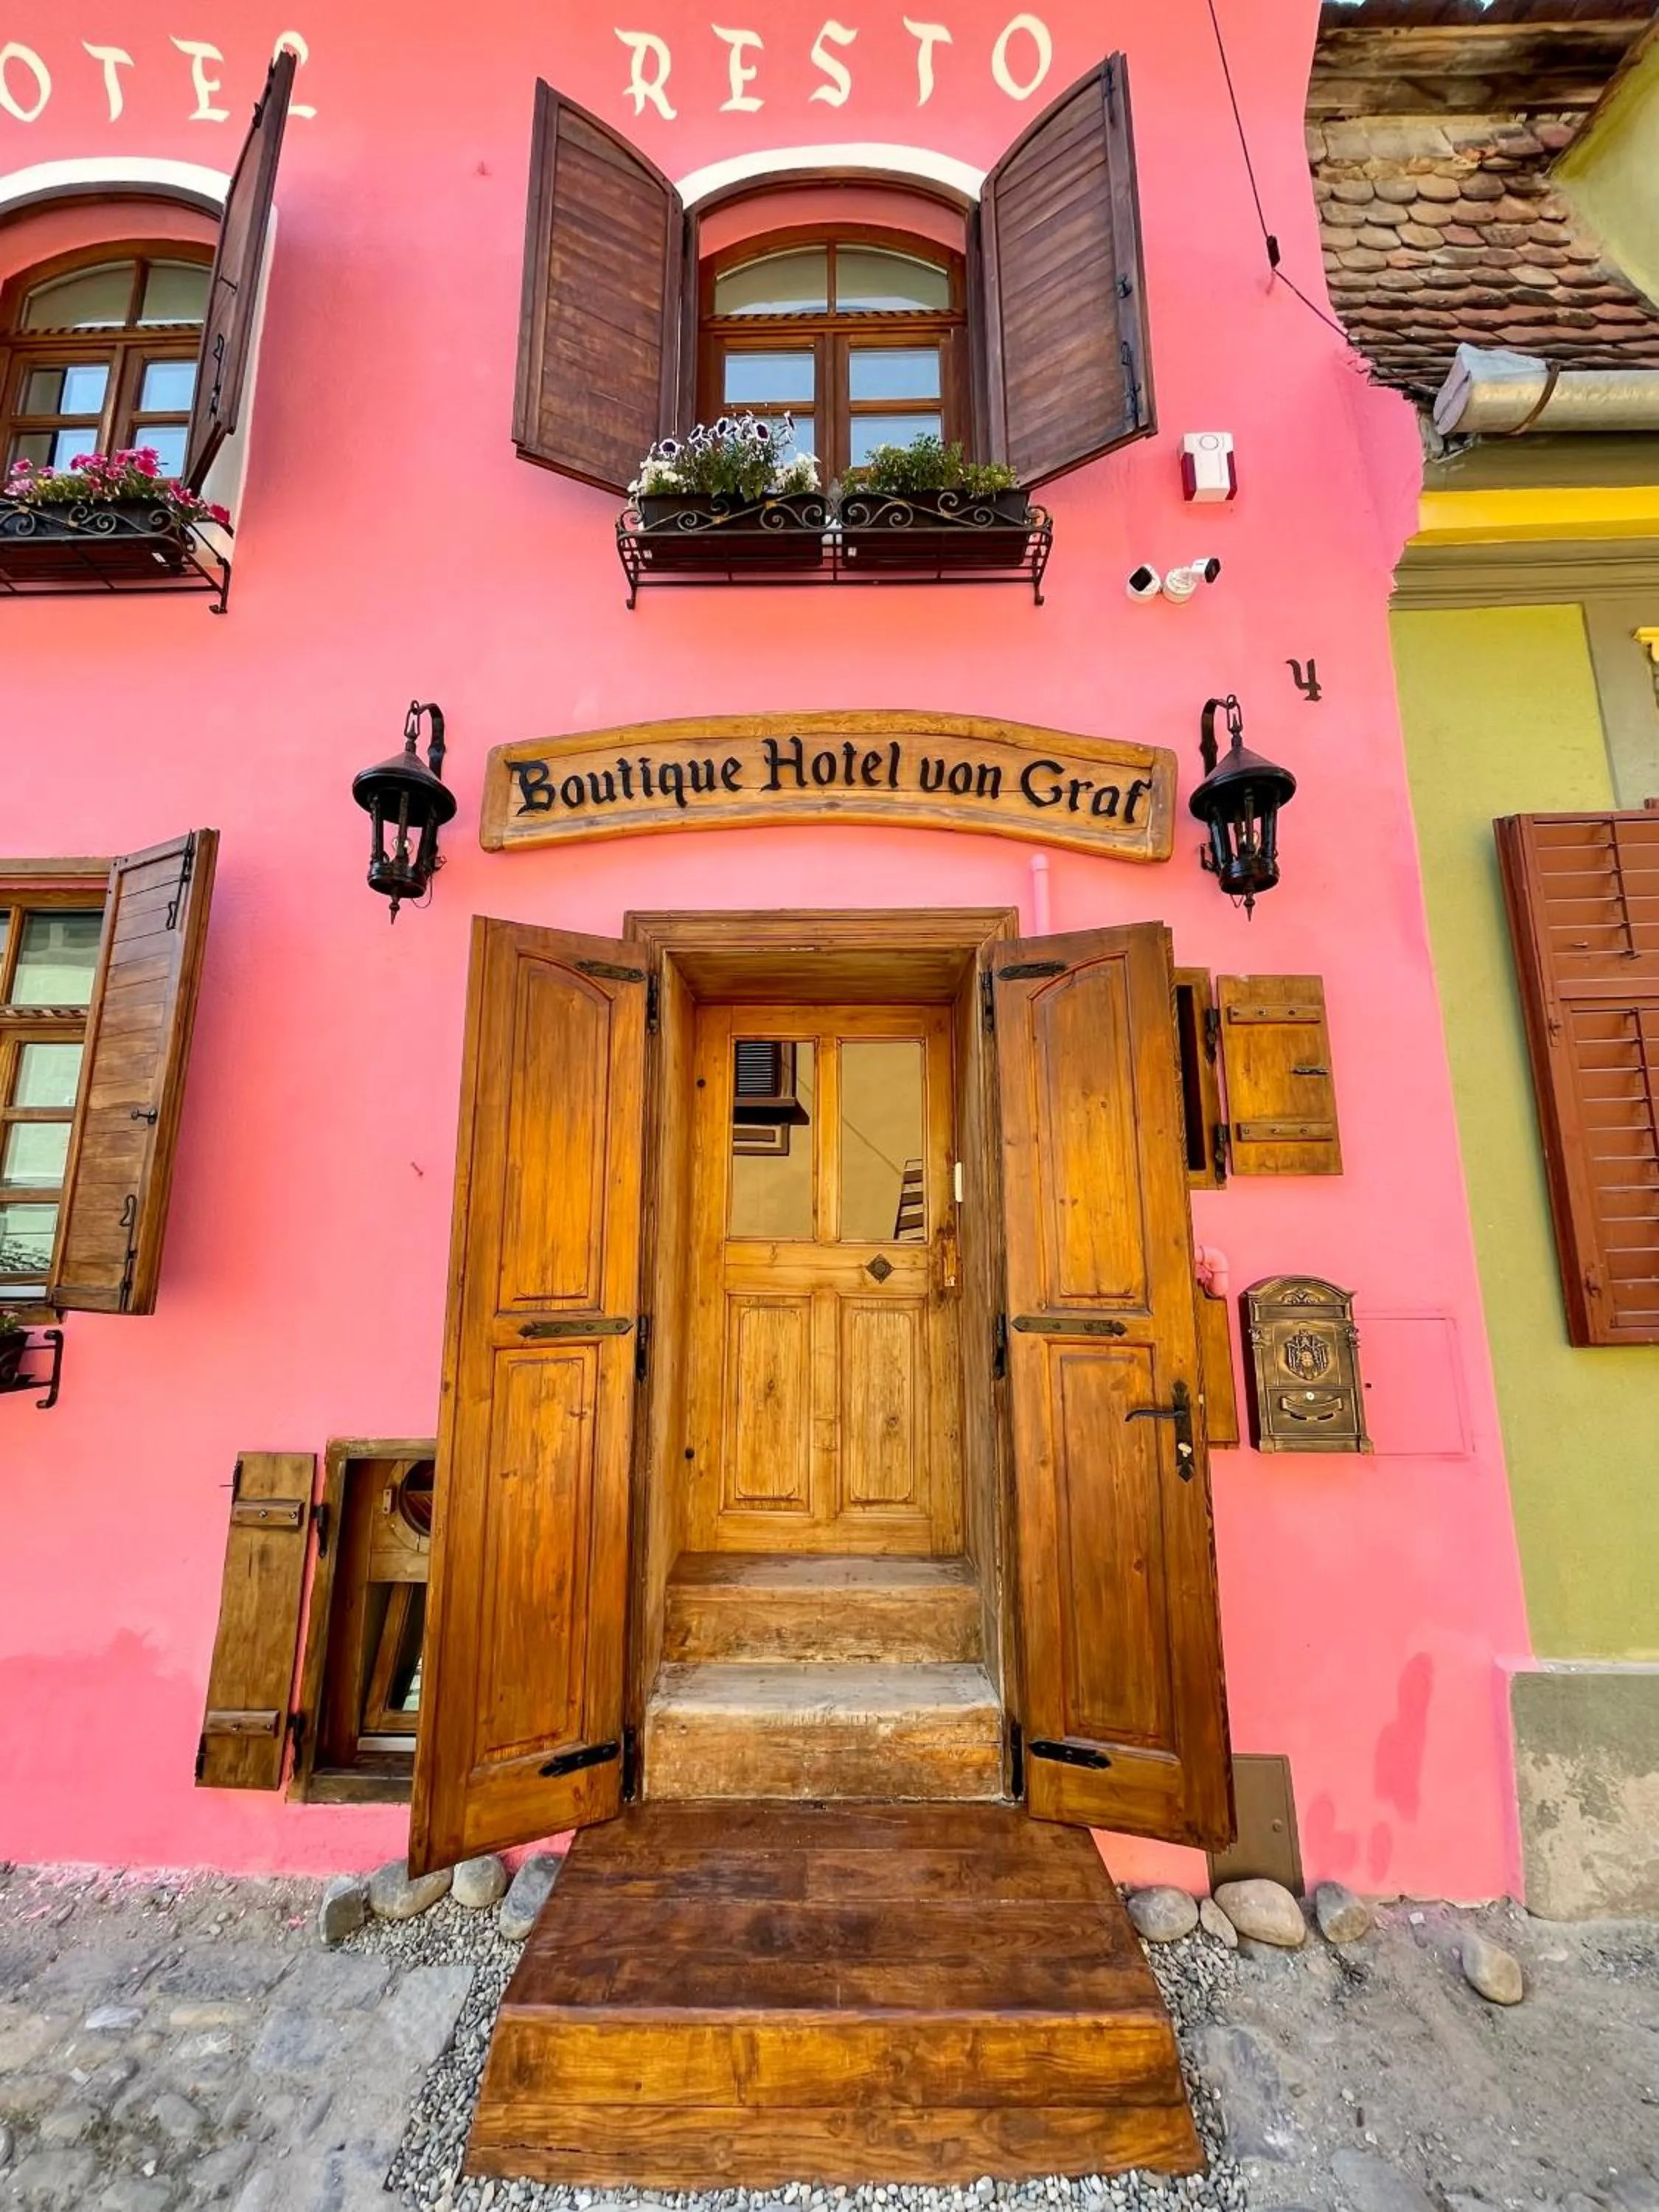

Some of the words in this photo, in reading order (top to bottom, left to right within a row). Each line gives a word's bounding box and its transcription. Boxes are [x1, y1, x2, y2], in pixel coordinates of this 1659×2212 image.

[613, 13, 1052, 120] RESTO
[1284, 658, 1322, 701] 4
[505, 755, 742, 815] Boutique
[762, 737, 901, 791] Hotel
[919, 757, 1001, 799] von
[1020, 759, 1152, 824] Graf
